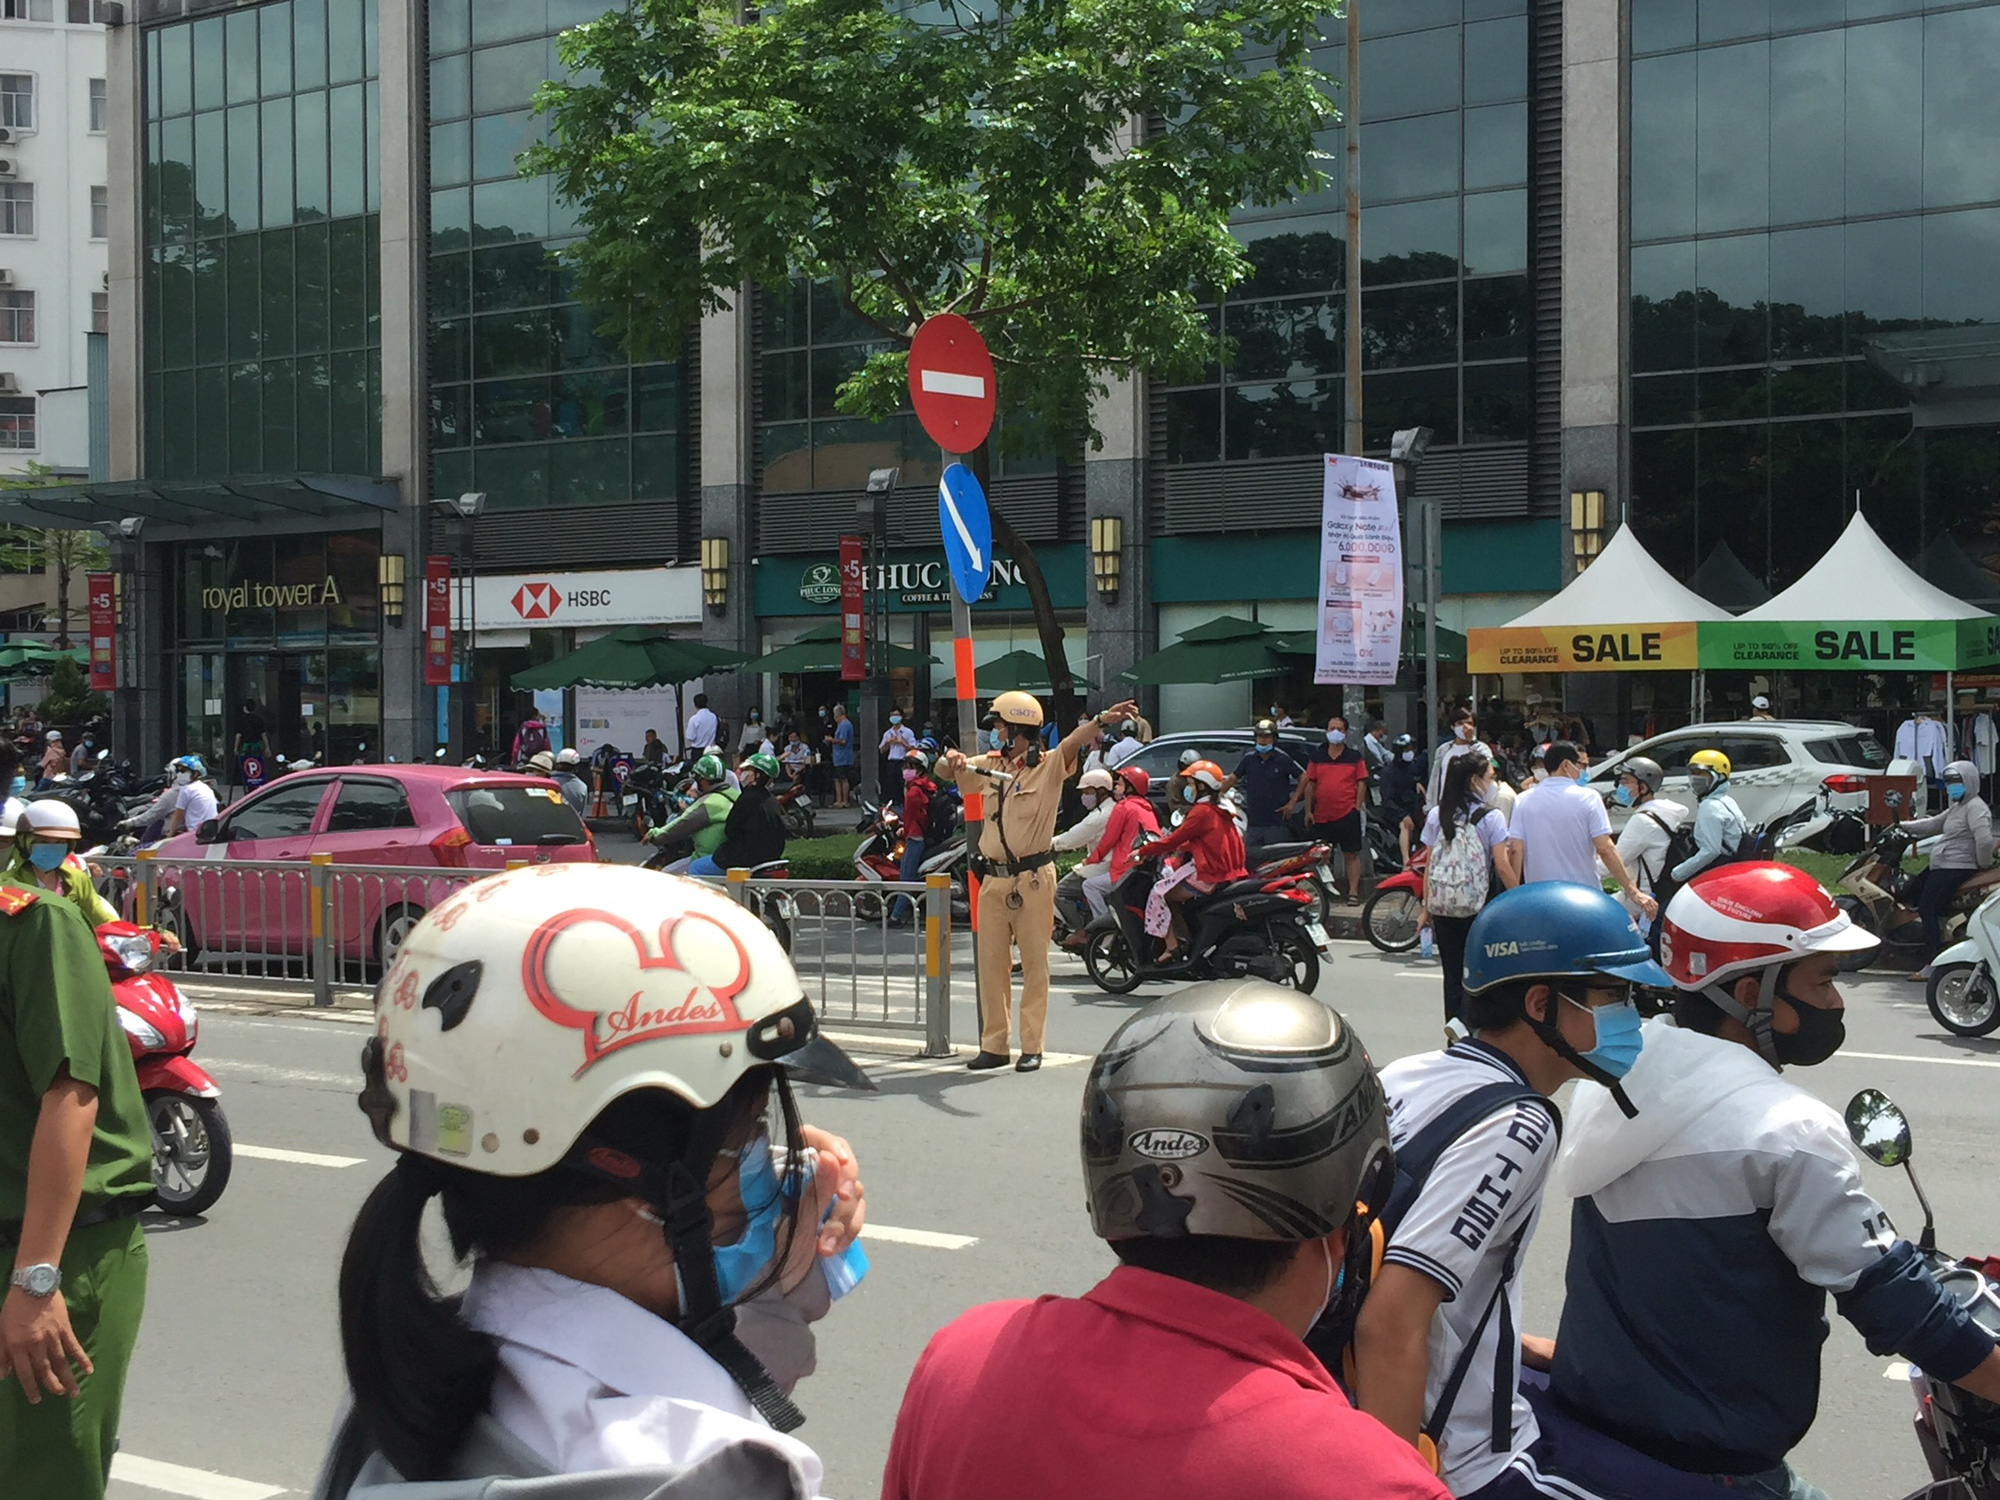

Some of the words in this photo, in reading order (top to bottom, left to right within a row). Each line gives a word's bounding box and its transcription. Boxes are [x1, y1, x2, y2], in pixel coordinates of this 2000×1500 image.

[1327, 520, 1354, 532] Galaxy
[203, 579, 249, 615] royal
[254, 582, 316, 608] tower
[320, 575, 340, 605] A
[568, 590, 611, 608] HSBC
[902, 594, 931, 602] COFFEE
[1572, 633, 1662, 663] SALE
[1814, 630, 1916, 660] SALE
[1500, 655, 1559, 664] CLEARANCE
[1733, 651, 1800, 660] CLEARANCE
[1484, 941, 1519, 957] VISA
[598, 987, 721, 1044] Andes
